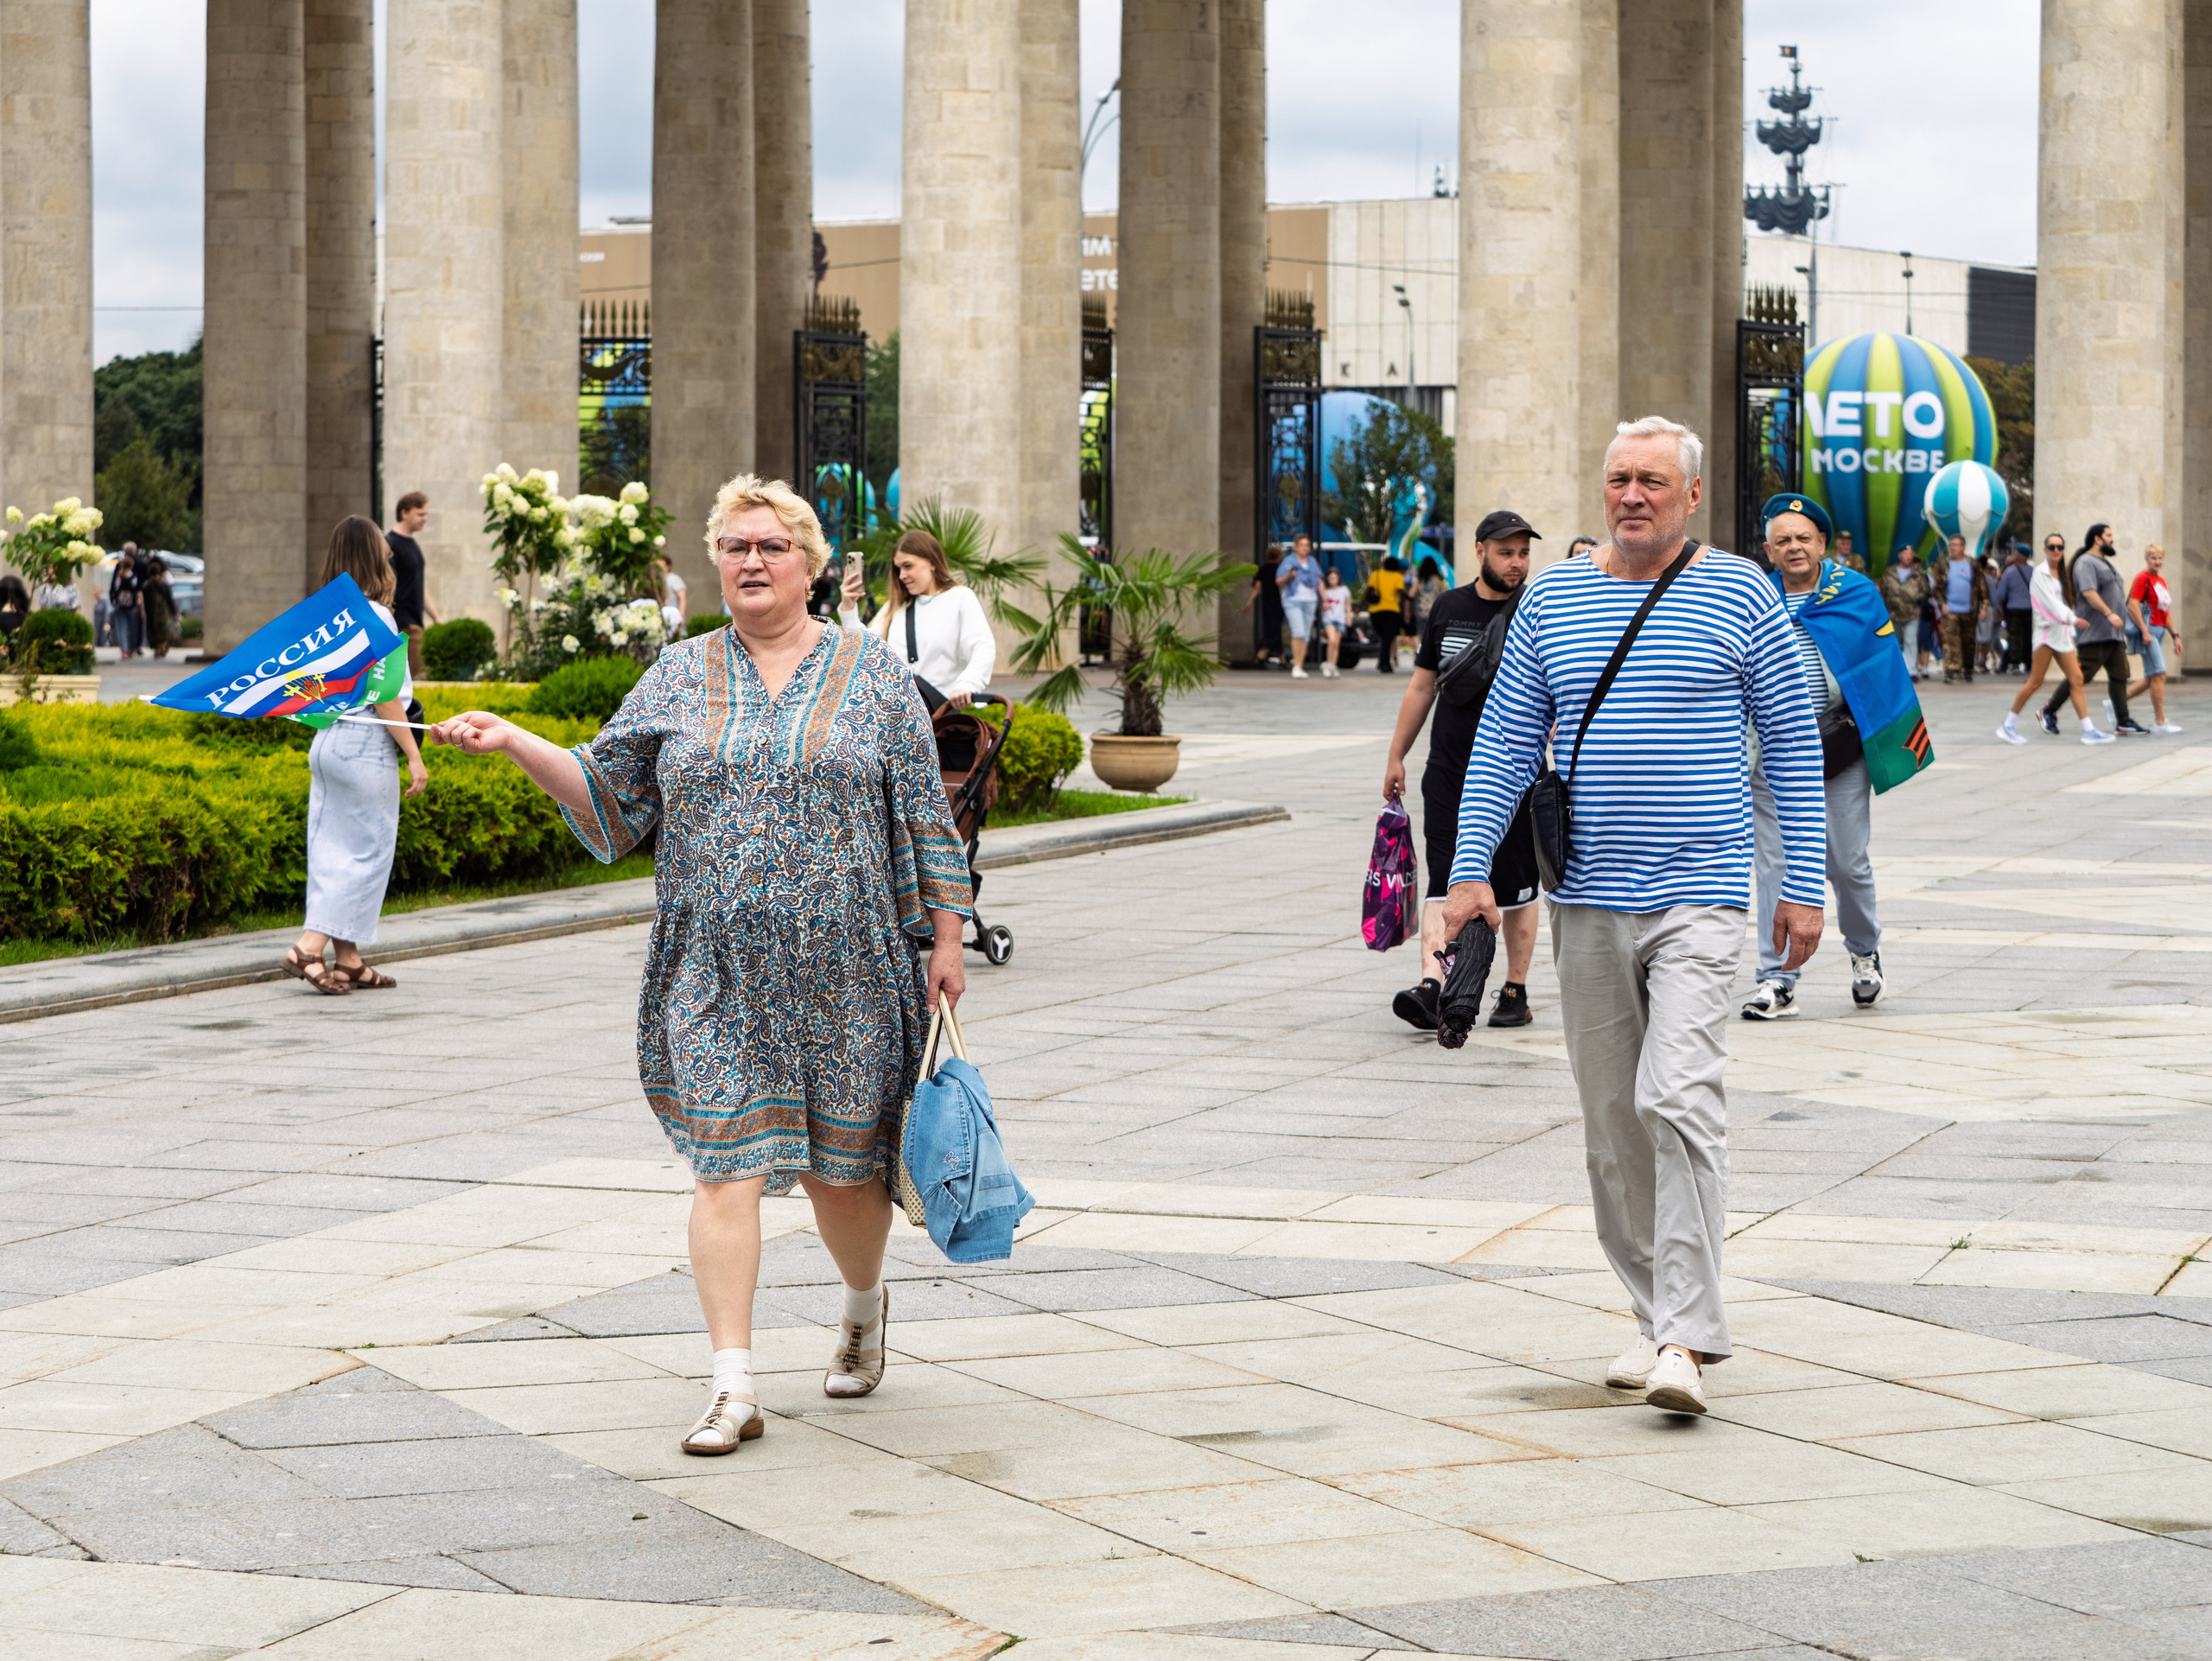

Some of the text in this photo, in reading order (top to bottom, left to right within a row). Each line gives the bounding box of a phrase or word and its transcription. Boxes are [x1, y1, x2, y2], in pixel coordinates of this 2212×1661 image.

[1810, 448, 1944, 474] МОСКВЕ
[205, 608, 357, 710] РОССИЯ
[372, 657, 387, 681] НА
